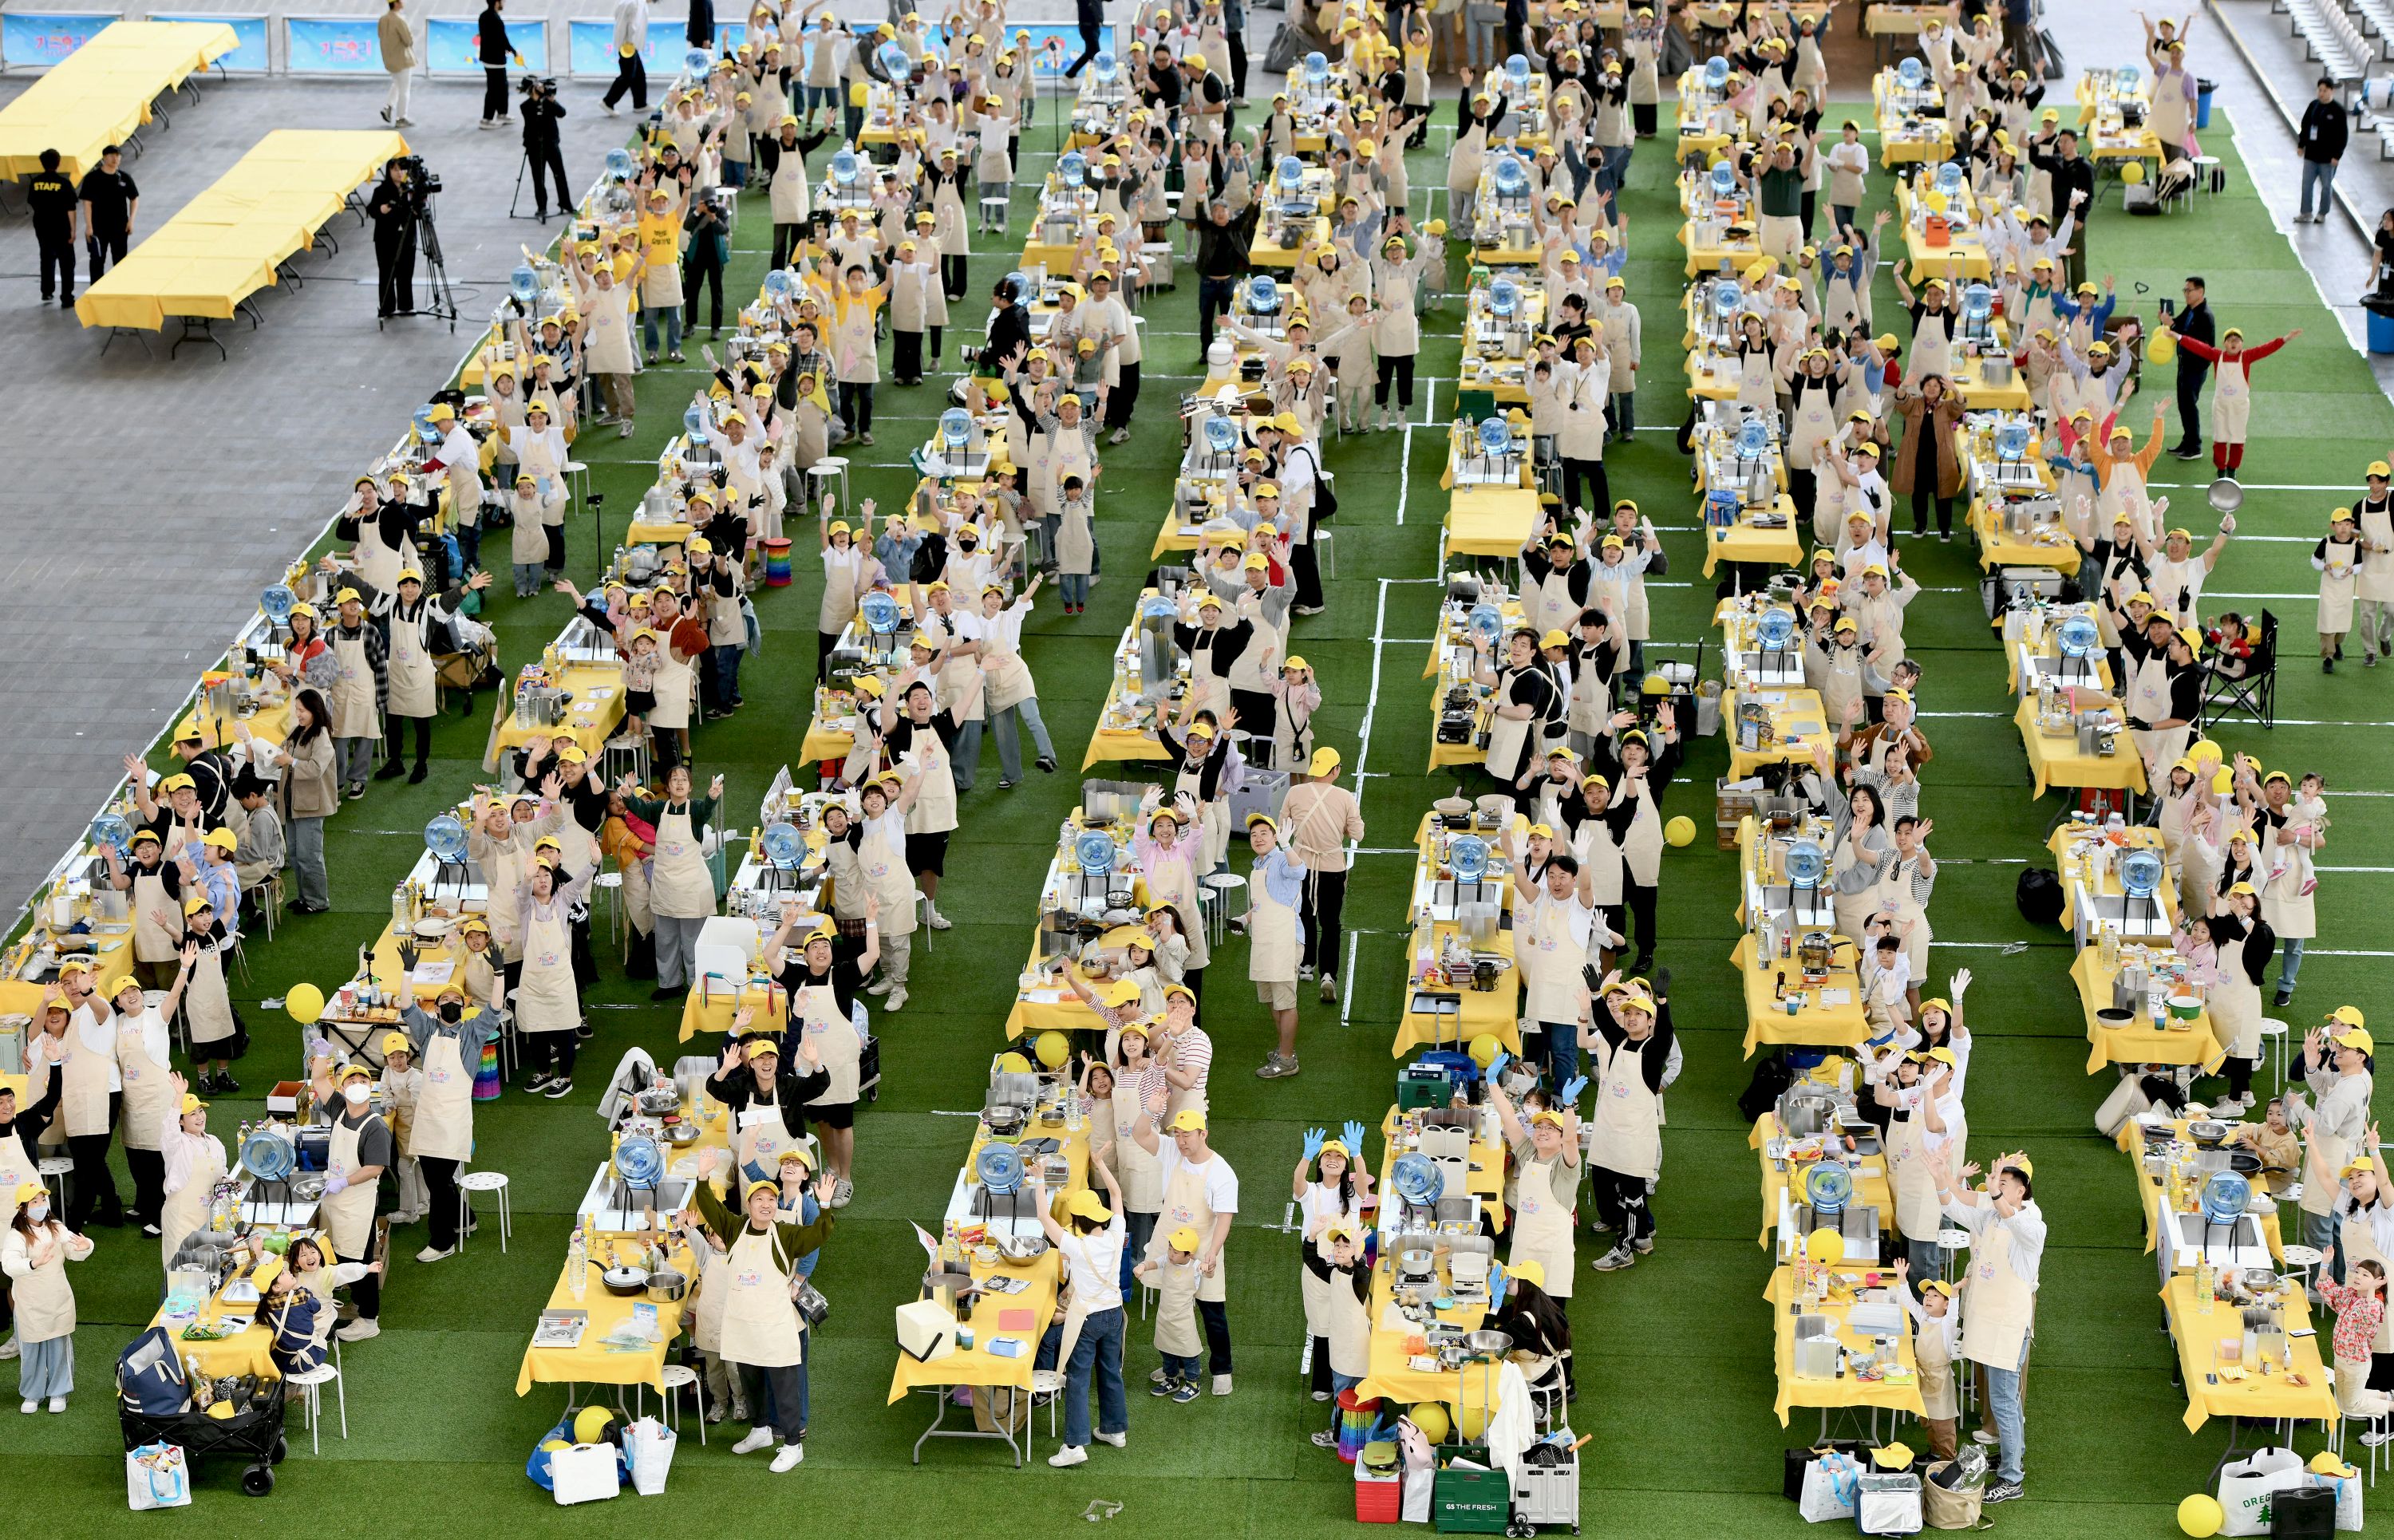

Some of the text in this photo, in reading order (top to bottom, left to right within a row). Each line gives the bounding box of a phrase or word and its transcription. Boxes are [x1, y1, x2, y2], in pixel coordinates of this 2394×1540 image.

[34, 182, 61, 192] STAFF
[200, 946, 215, 955] ANKE
[2243, 1493, 2271, 1507] OREG
